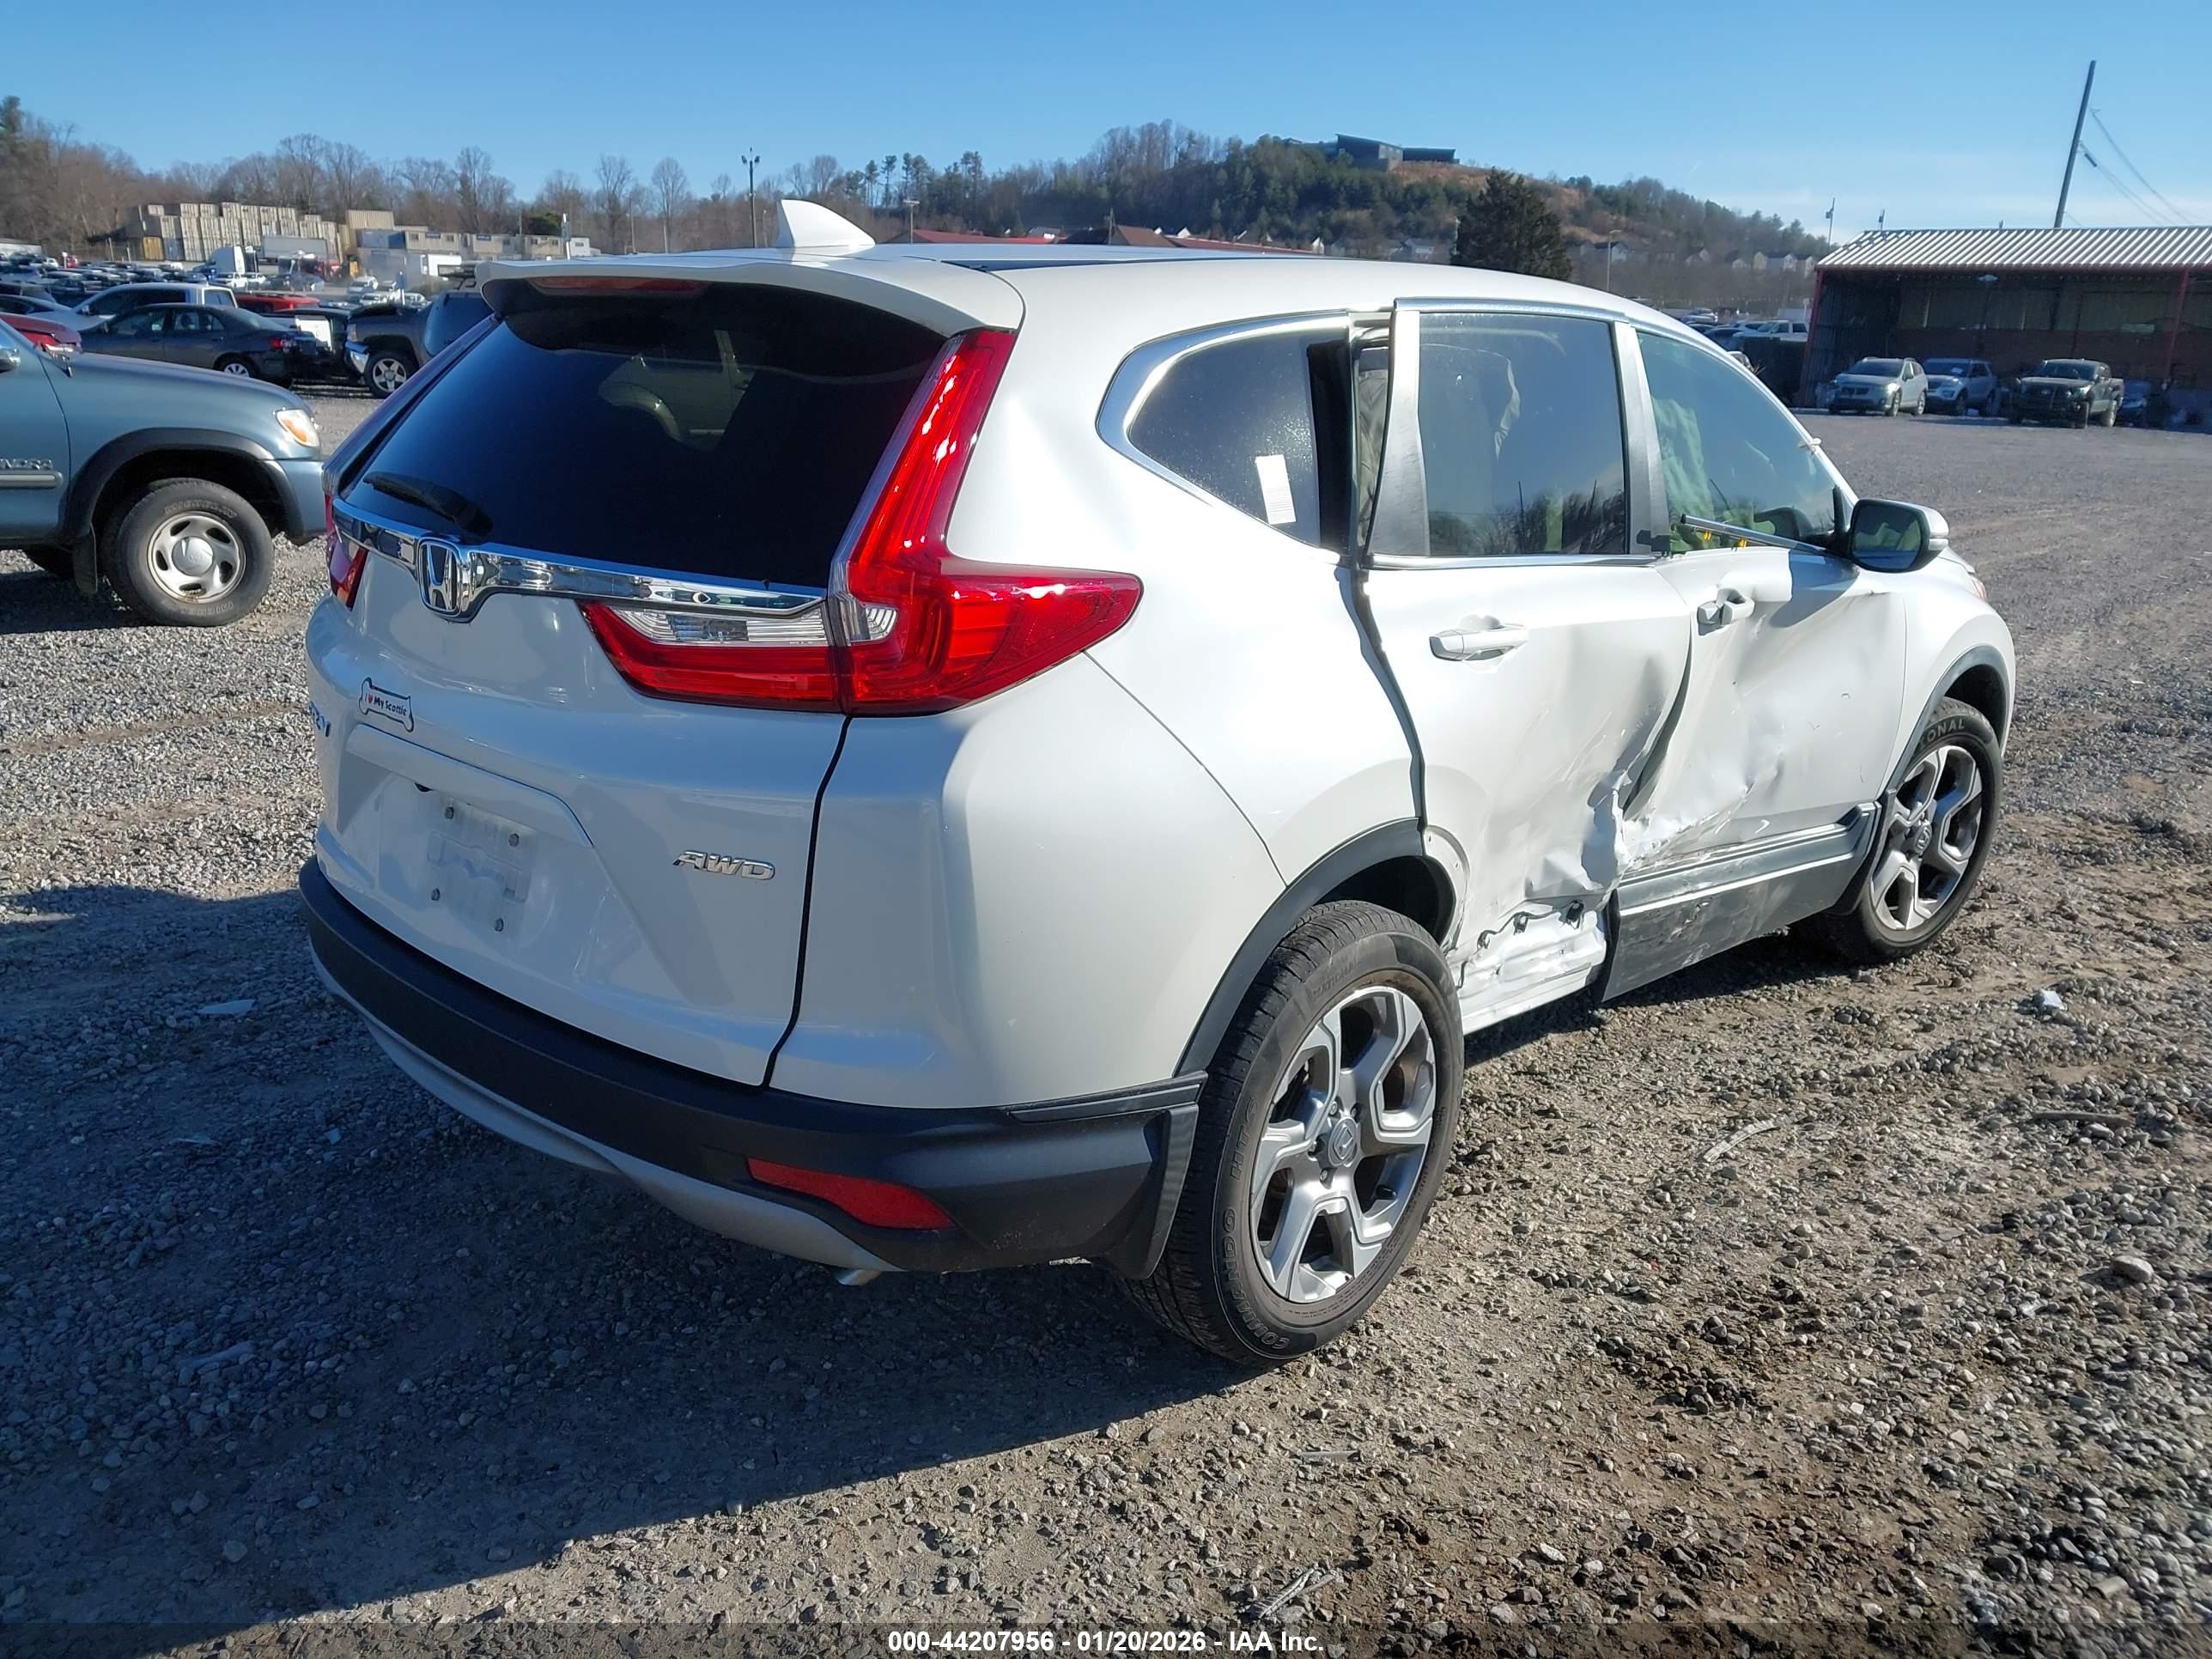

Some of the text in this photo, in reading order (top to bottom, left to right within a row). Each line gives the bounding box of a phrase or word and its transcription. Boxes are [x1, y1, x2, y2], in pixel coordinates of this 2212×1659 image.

[374, 696, 385, 710] My
[386, 700, 407, 717] Scottie
[672, 849, 776, 881] AWD
